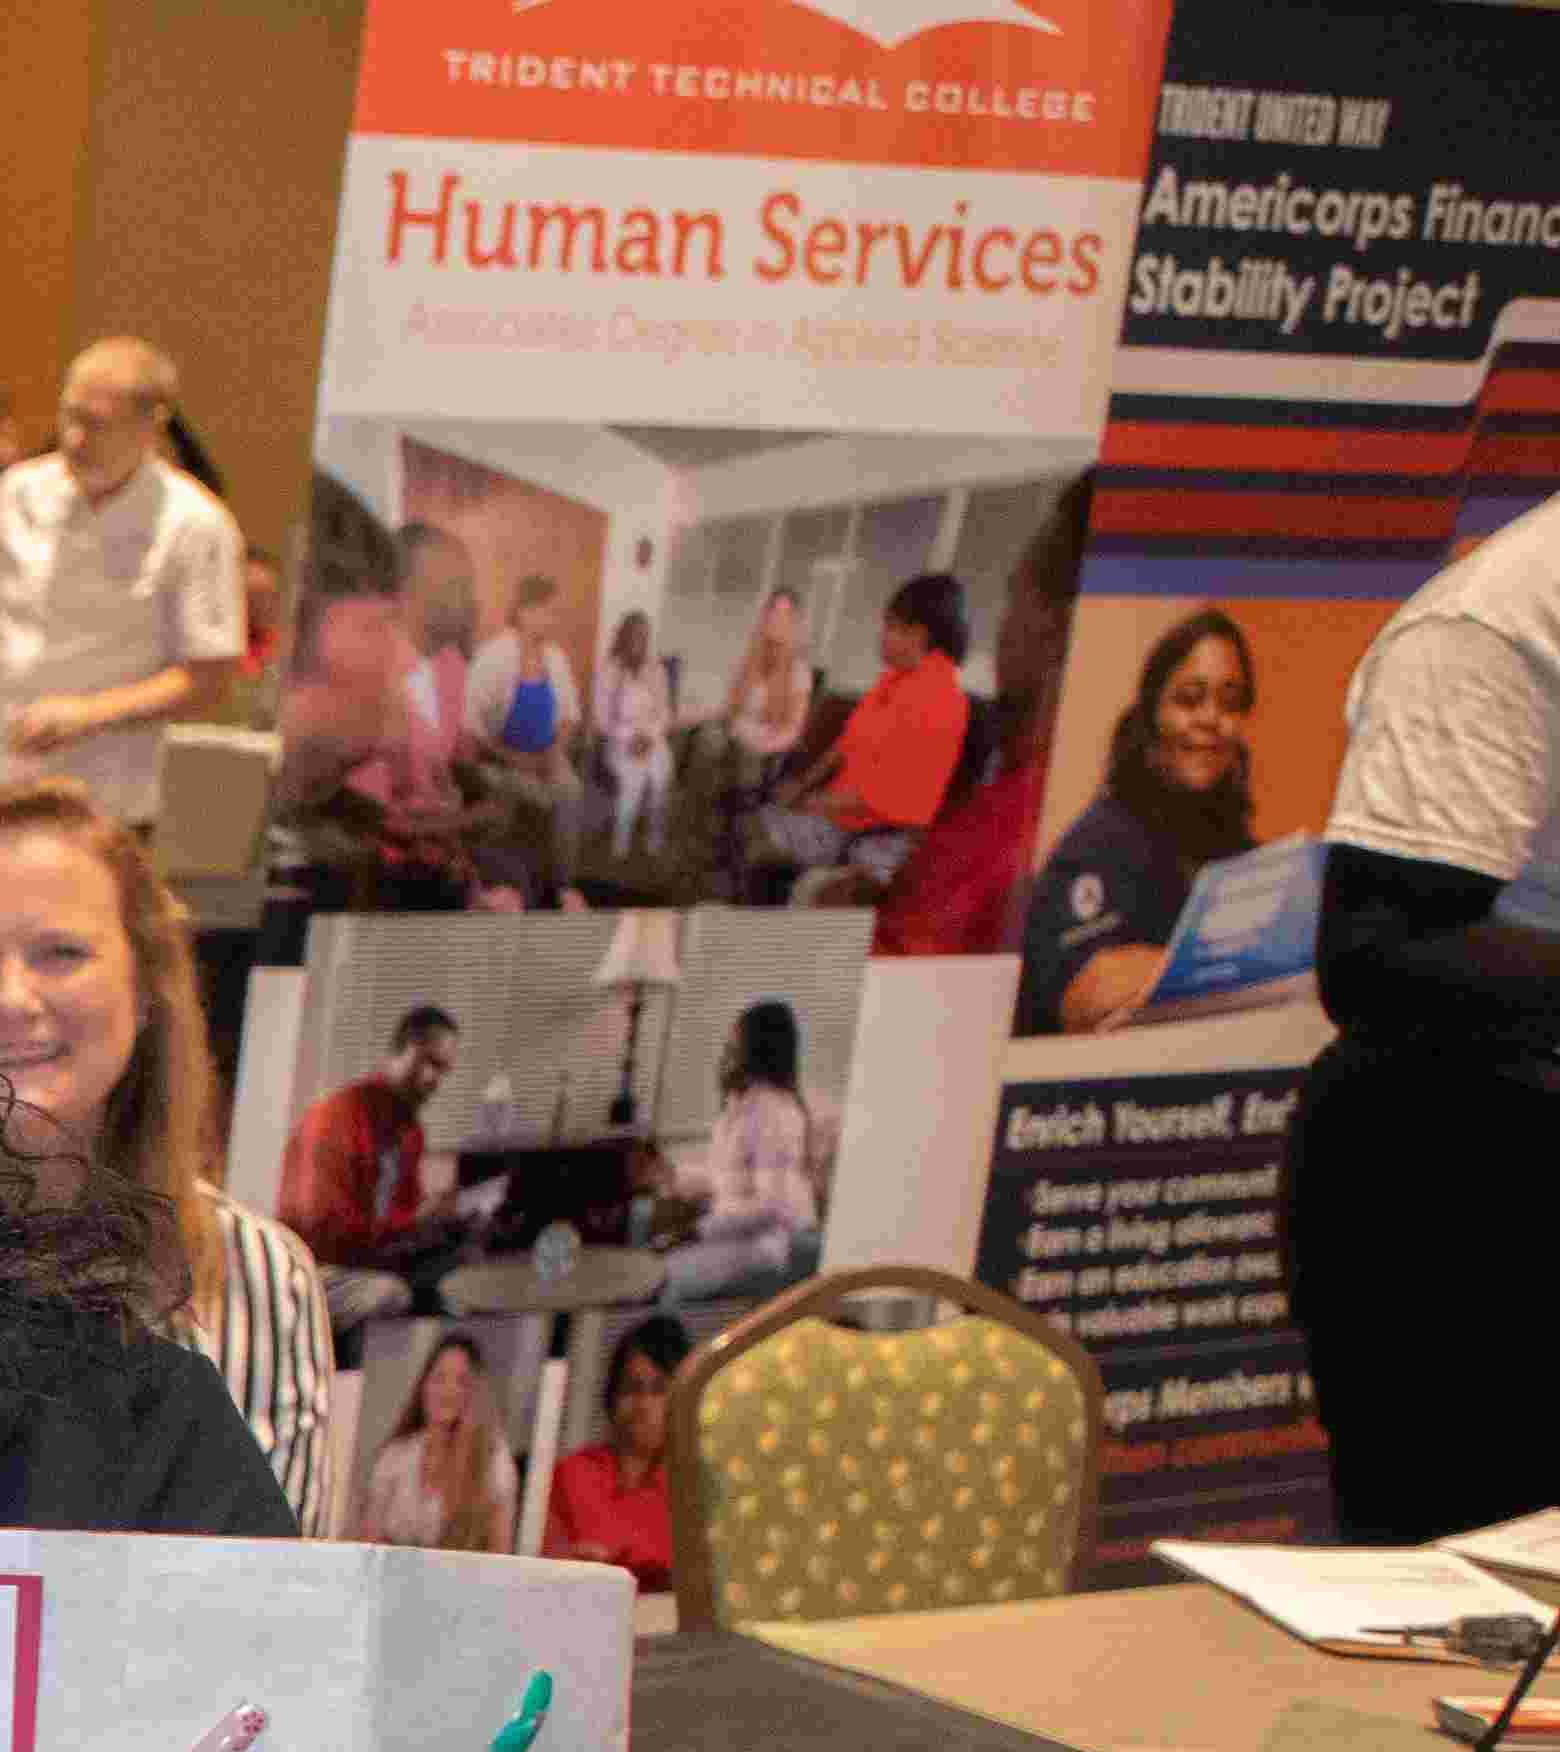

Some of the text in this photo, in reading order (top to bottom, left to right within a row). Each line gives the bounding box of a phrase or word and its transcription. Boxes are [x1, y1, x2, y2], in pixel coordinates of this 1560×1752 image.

[442, 48, 1098, 123] TRIDENT TECHNICAL COLLEGE
[385, 168, 1103, 297] Human Services
[1143, 163, 1415, 252] Americorps
[1130, 254, 1480, 339] Stability Project
[1006, 1103, 1105, 1149] Enrich
